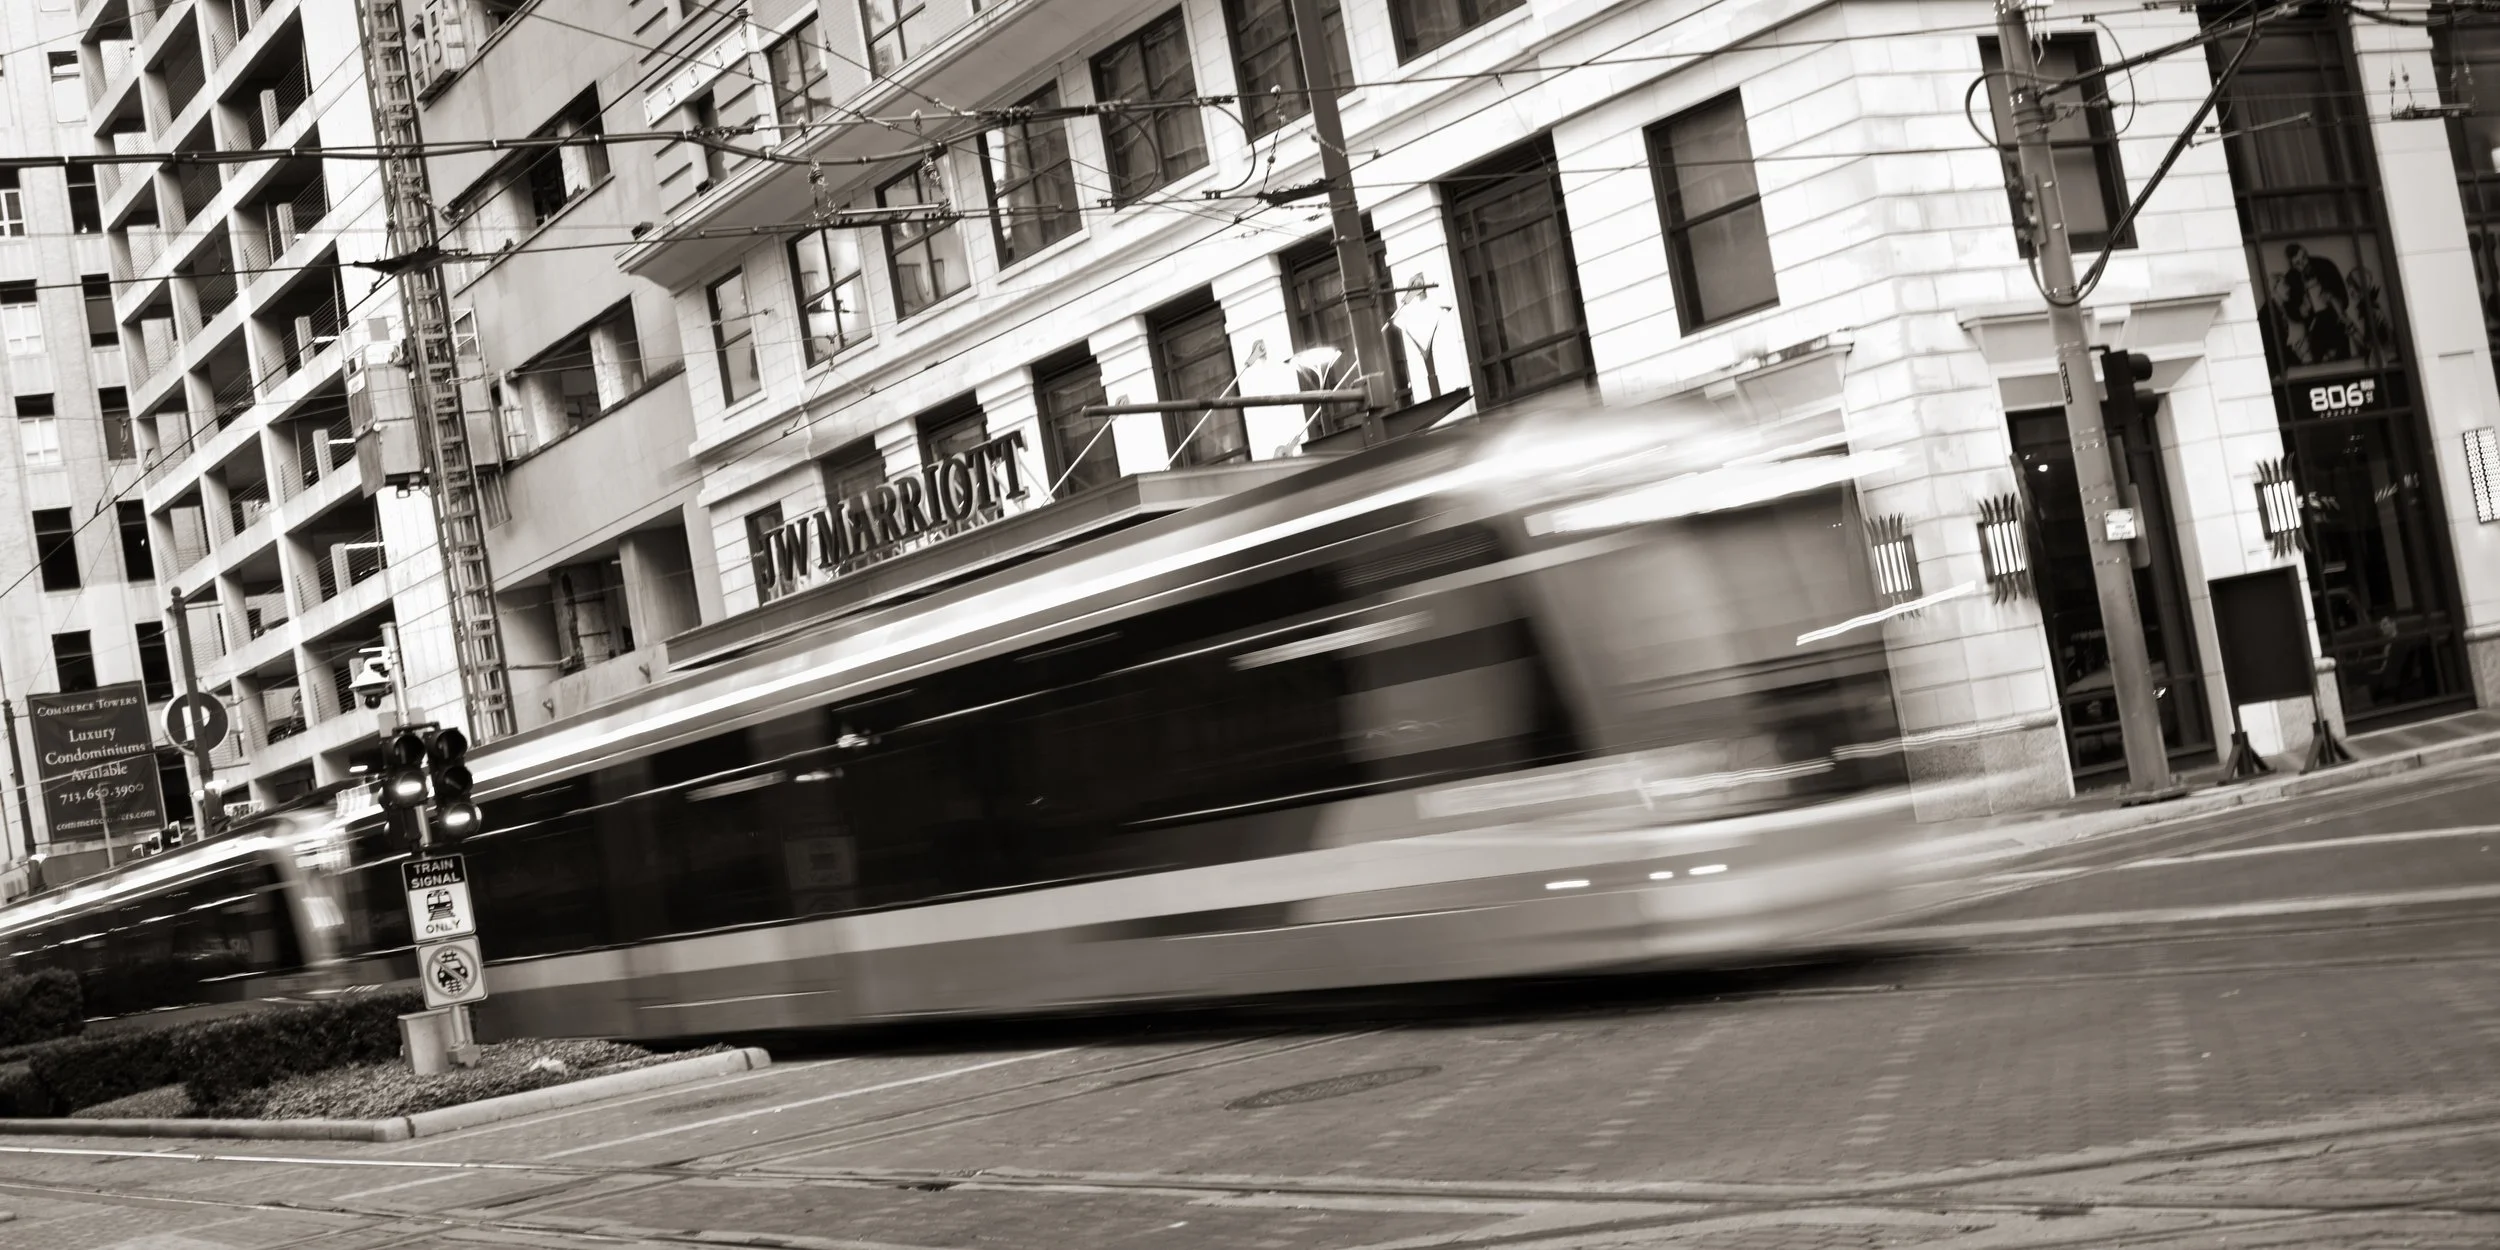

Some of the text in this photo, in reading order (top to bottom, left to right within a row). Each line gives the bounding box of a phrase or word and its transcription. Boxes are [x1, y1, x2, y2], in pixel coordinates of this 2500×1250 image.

[2309, 382, 2364, 412] 806
[759, 430, 1029, 592] JW MARRIOTT
[37, 696, 138, 717] COMMERCE TOWERS
[69, 727, 116, 743] Luxury
[45, 744, 146, 765] Condominiums
[71, 761, 128, 781] Available
[60, 783, 144, 805] 713.650.3900
[412, 858, 455, 875] TRAIN
[411, 872, 461, 889] SIGNAL
[426, 919, 461, 934] ONLY
